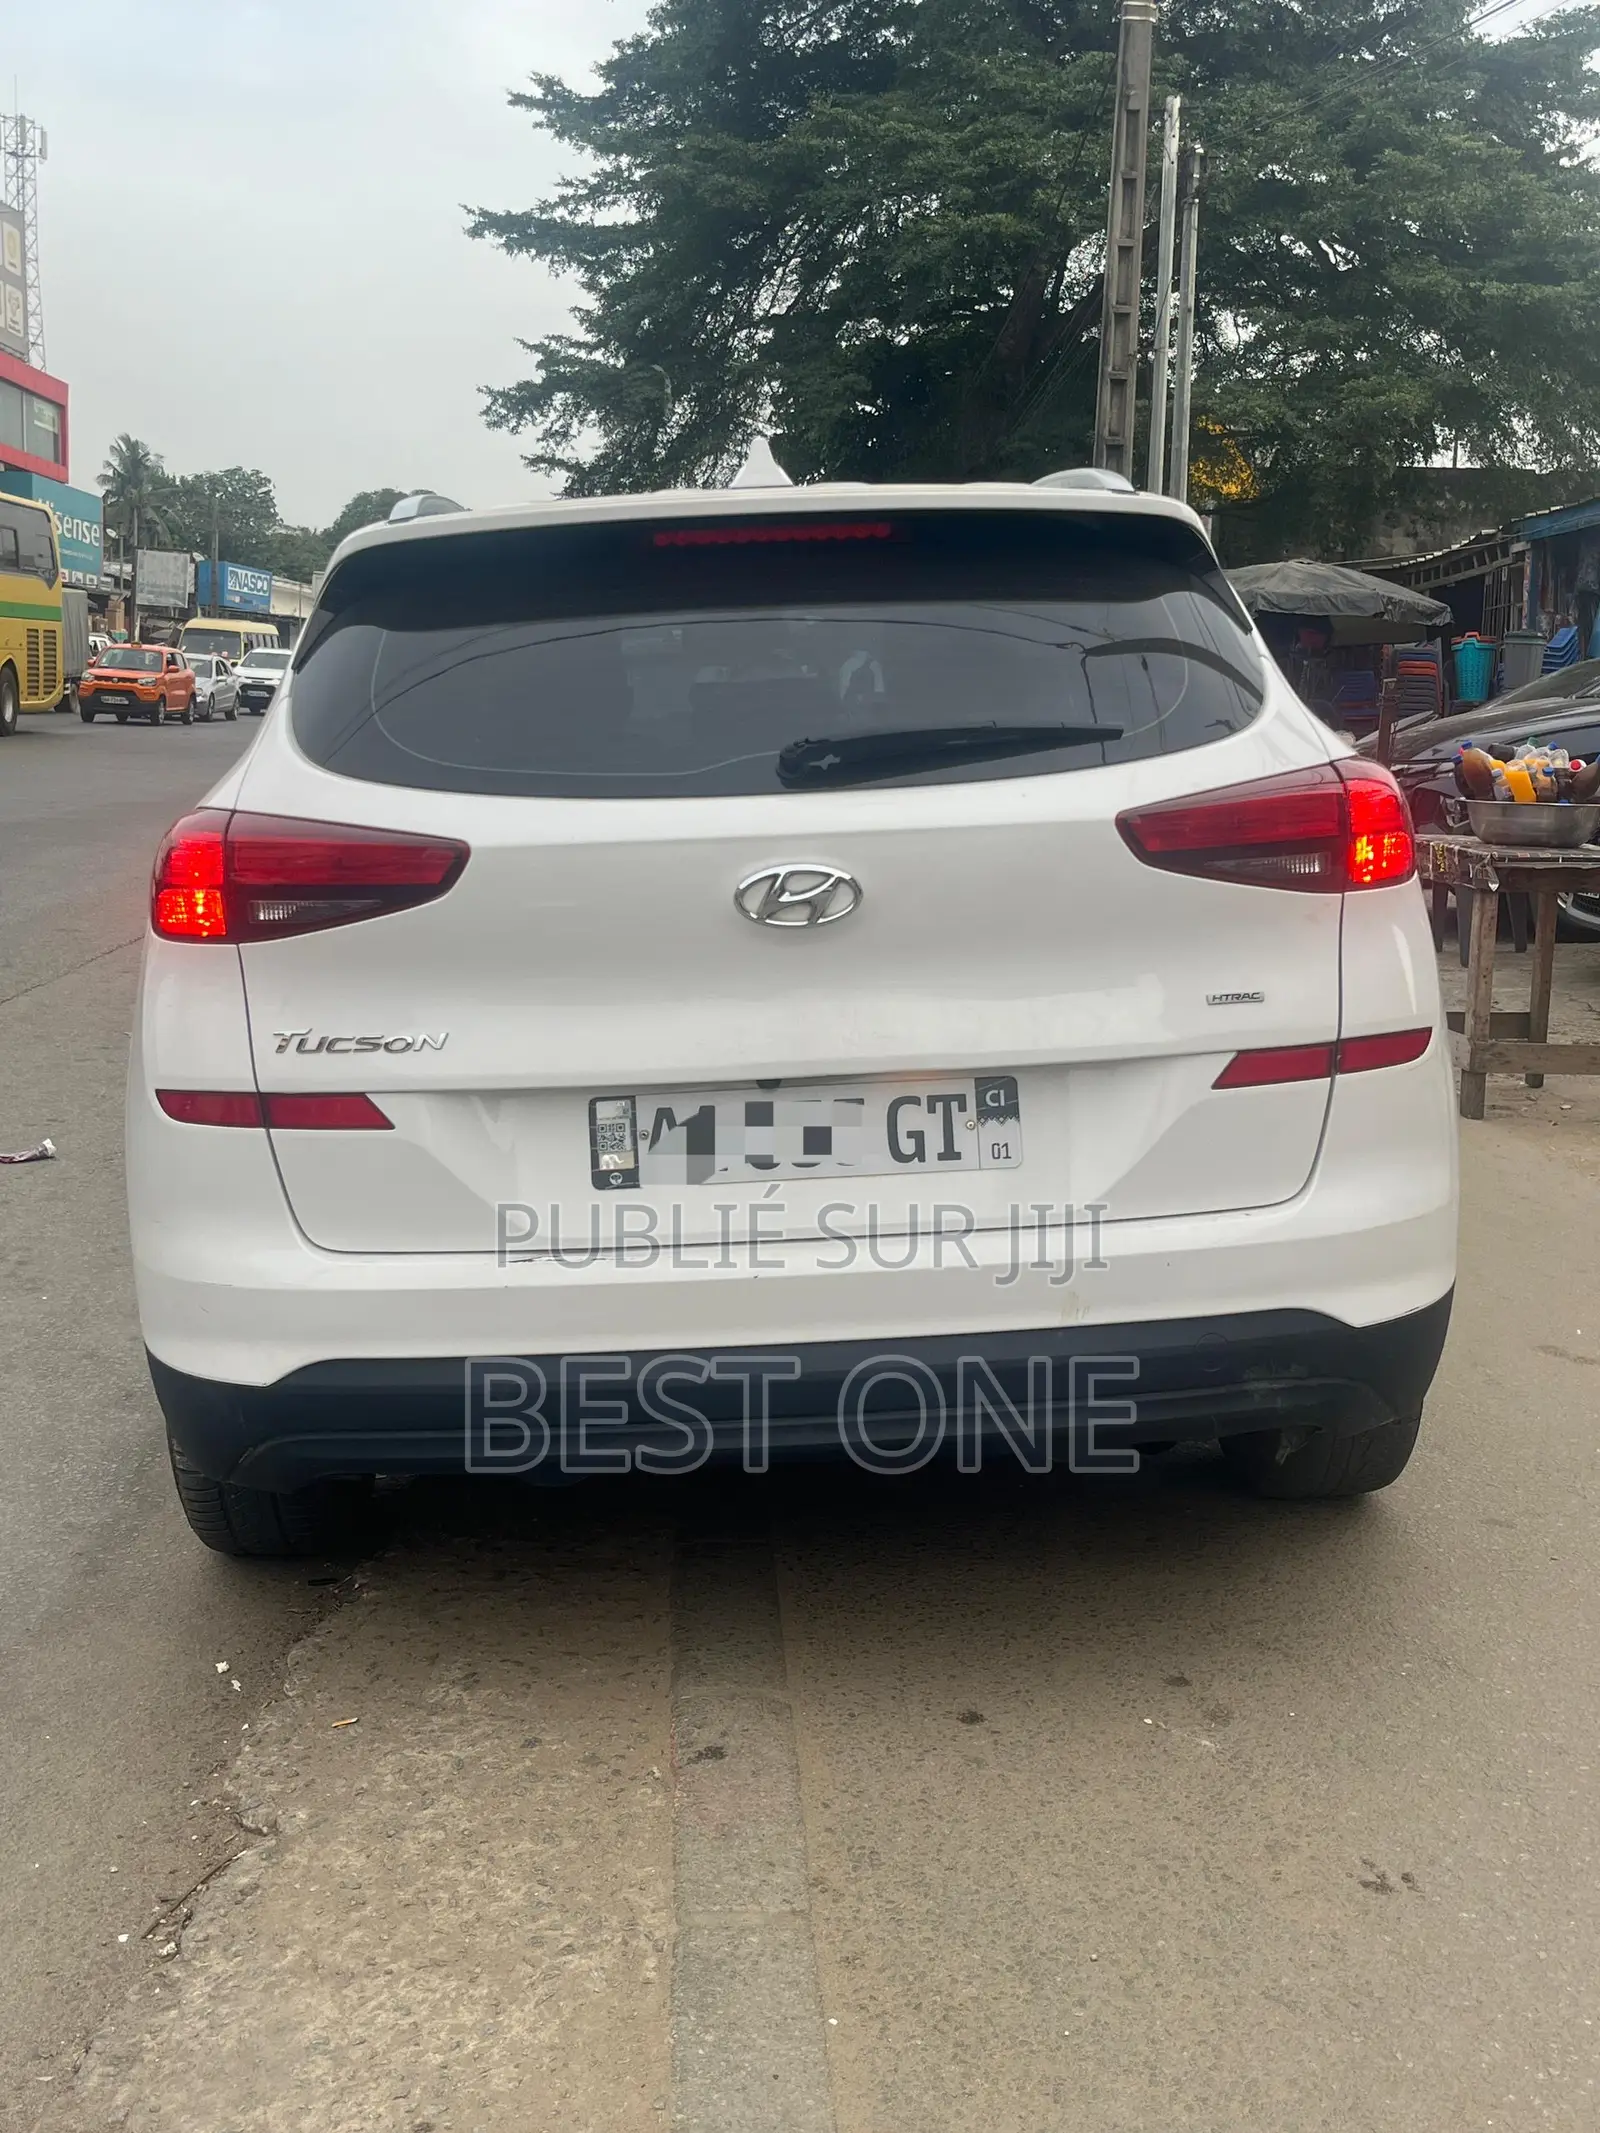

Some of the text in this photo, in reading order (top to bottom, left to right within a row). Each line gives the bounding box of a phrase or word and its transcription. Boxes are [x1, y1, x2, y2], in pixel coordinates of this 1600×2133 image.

[235, 570, 269, 594] NASCO
[1212, 992, 1260, 1002] HTRAC
[273, 1028, 449, 1054] TUCSON
[985, 1089, 1005, 1107] CI
[887, 1094, 967, 1163] GT
[991, 1142, 1012, 1160] 01
